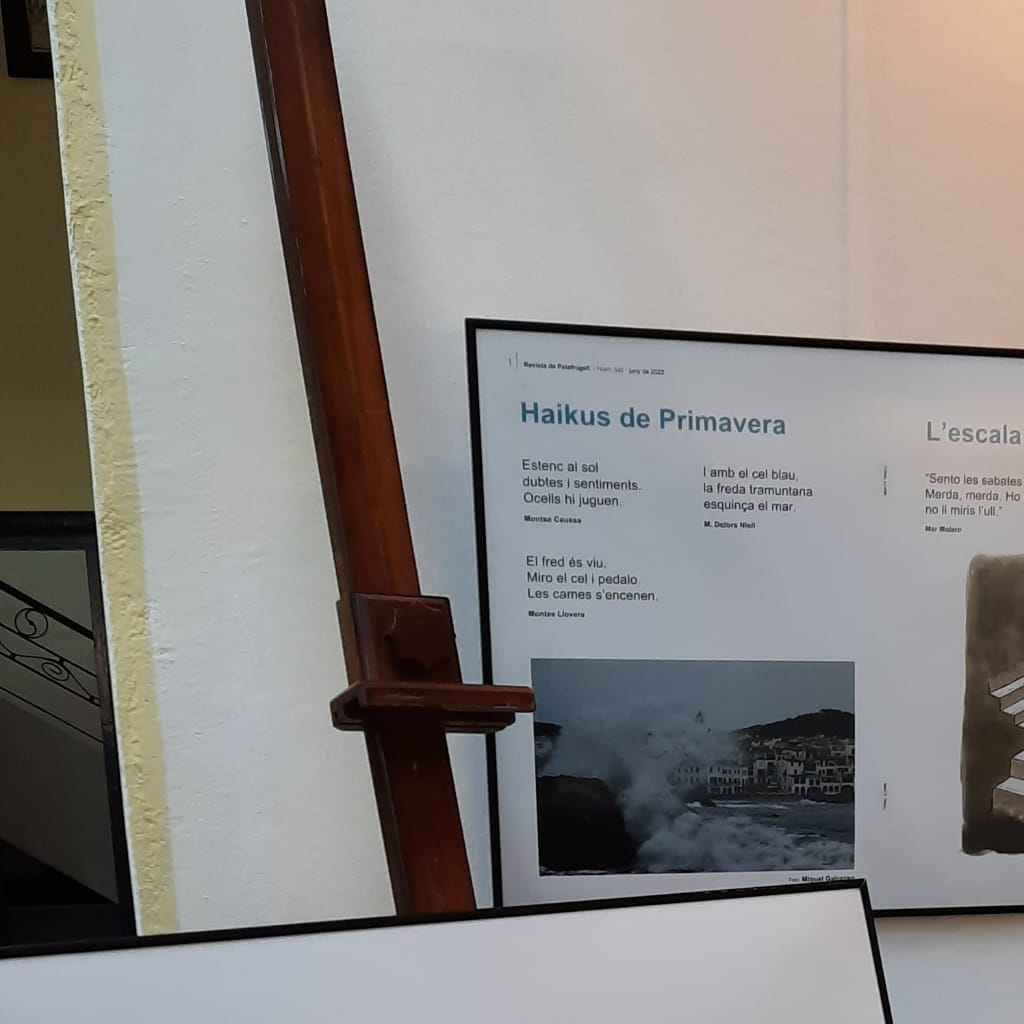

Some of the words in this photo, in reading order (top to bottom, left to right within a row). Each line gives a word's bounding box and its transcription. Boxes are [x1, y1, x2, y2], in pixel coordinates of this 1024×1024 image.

[520, 401, 610, 426] Haikus
[619, 406, 650, 428] de
[659, 408, 785, 434] Primavera
[926, 421, 1022, 446] L'escala
[521, 459, 564, 472] Estenc
[567, 461, 578, 472] al
[581, 461, 600, 473] sol
[703, 466, 706, 477] I
[710, 467, 735, 478] amb
[738, 467, 748, 479] el
[751, 468, 768, 479] cel
[771, 468, 799, 482] blau,
[963, 474, 979, 486] les
[981, 475, 1023, 487] sabates
[522, 476, 563, 488] dubtes
[566, 477, 570, 489] i
[574, 478, 641, 491] sentiments.
[703, 482, 713, 494] la
[716, 483, 746, 495] freda
[749, 484, 813, 497] tramuntana
[523, 492, 561, 505] Ocells
[564, 493, 576, 505] hi
[579, 494, 622, 509] juguen.
[925, 488, 962, 502] Merda,
[1005, 490, 1021, 502] Ho
[703, 499, 755, 513] esquinça
[758, 500, 768, 511] el
[771, 503, 797, 512] mar.
[925, 505, 939, 515] no
[942, 503, 947, 515] li
[950, 504, 976, 515] miris
[526, 555, 538, 567] El
[542, 555, 565, 567] fred
[568, 556, 583, 568] és
[586, 557, 607, 568] viu.
[527, 572, 553, 583] Miro
[556, 572, 567, 584] el
[570, 573, 588, 584] cel
[591, 573, 595, 584] i
[598, 573, 641, 587] pedalo.
[527, 587, 549, 599] Les
[552, 590, 592, 600] cames
[595, 589, 658, 601] s'encenen.
